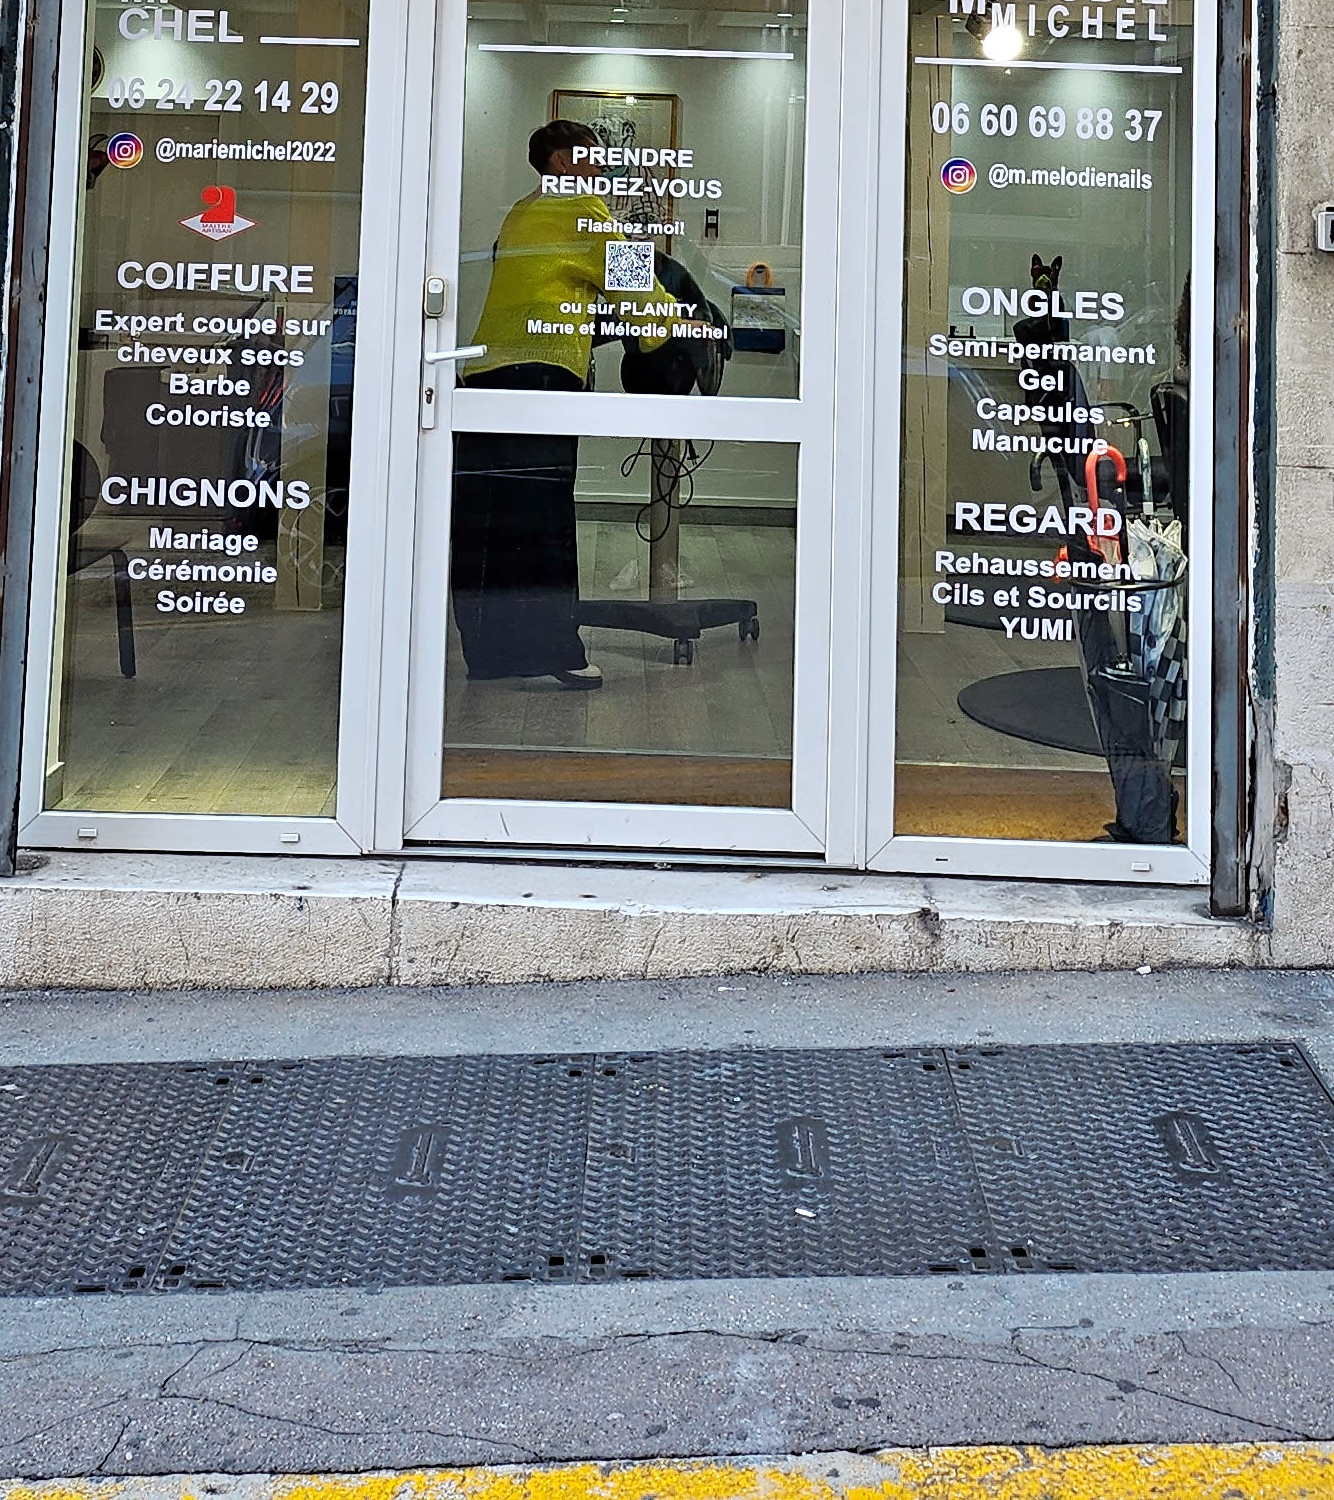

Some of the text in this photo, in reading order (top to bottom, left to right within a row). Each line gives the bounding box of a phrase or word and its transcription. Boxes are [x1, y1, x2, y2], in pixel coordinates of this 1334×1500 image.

[118, 8, 244, 43] CHEL
[990, 3, 1167, 41] MICHEL
[107, 76, 340, 115] 06 24 22 14 29
[932, 101, 1163, 142] 06 60 69 88 37
[155, 136, 336, 163] @mariemichel2022
[571, 146, 694, 169] PRENDRE
[540, 175, 723, 199] RENDEZ-VOUS
[988, 163, 1153, 190] @m.melodienails
[577, 218, 643, 234] Flashez
[117, 261, 315, 294] COIFFURE
[559, 301, 698, 318] ou sur PLANITY
[962, 286, 1125, 321] ONGLES
[94, 309, 331, 339] Expert coupe sur
[527, 319, 728, 339] Marie et Mélodie Michel
[117, 343, 305, 367] cheveux secs
[928, 334, 1156, 365] Semi-permanent
[169, 373, 250, 397] Barbe
[1018, 368, 1065, 392] Gel
[145, 404, 272, 429] Coloriste
[975, 398, 1105, 426] Capsules
[971, 430, 1108, 456] Manucure
[101, 476, 311, 510] CHIGNONS
[954, 501, 1123, 537] REGARD
[149, 527, 259, 556] Mariage
[127, 558, 278, 584] Cérémonie
[934, 551, 1142, 581] Rehaussement
[156, 590, 246, 614] Soirée
[931, 582, 1142, 612] Cils et Sourcils
[999, 616, 1073, 642] YUMI
